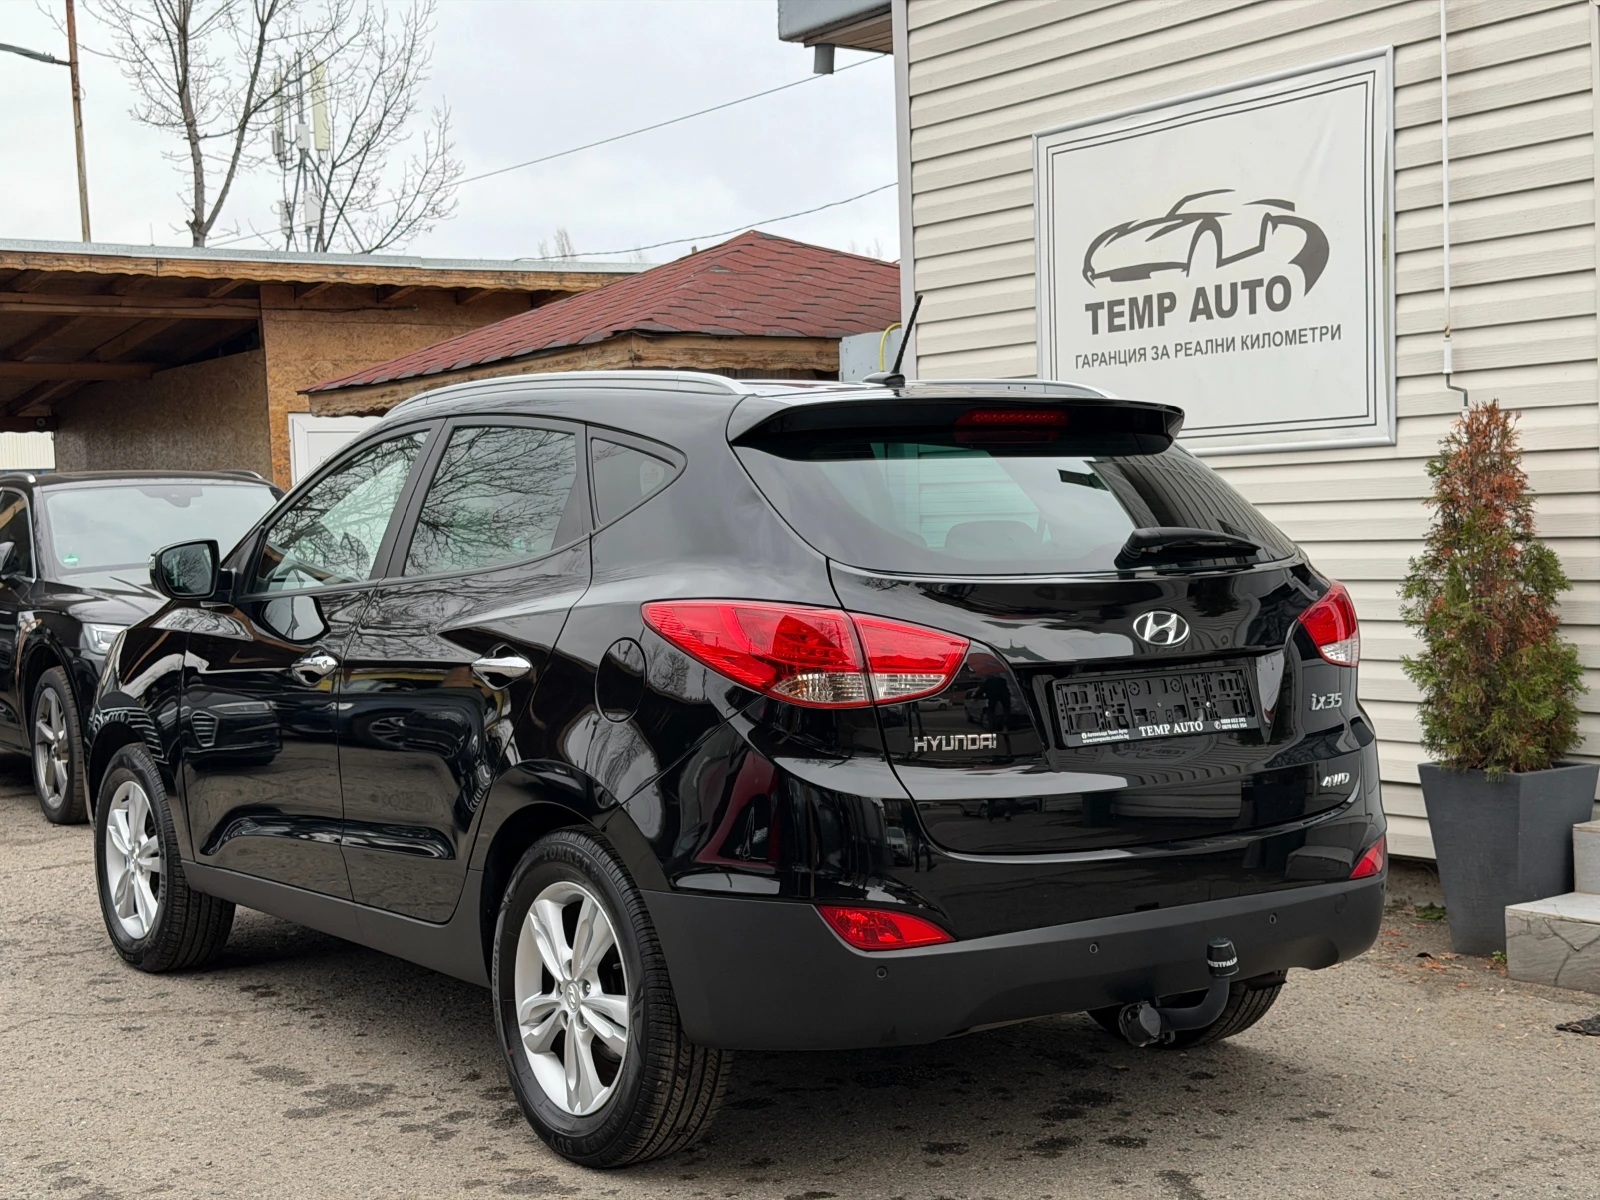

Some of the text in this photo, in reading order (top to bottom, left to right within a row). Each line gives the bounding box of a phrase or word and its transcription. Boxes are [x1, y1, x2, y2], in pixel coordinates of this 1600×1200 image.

[1084, 274, 1292, 335] TEMP AUTO
[1075, 324, 1342, 369] ГАРАНЦИЯ ЗА РЕАЛНИ КИЛОМЕТРИ
[913, 733, 997, 753] HYUNDAI
[1139, 722, 1171, 737] TEMP
[1173, 720, 1204, 734] AUTO
